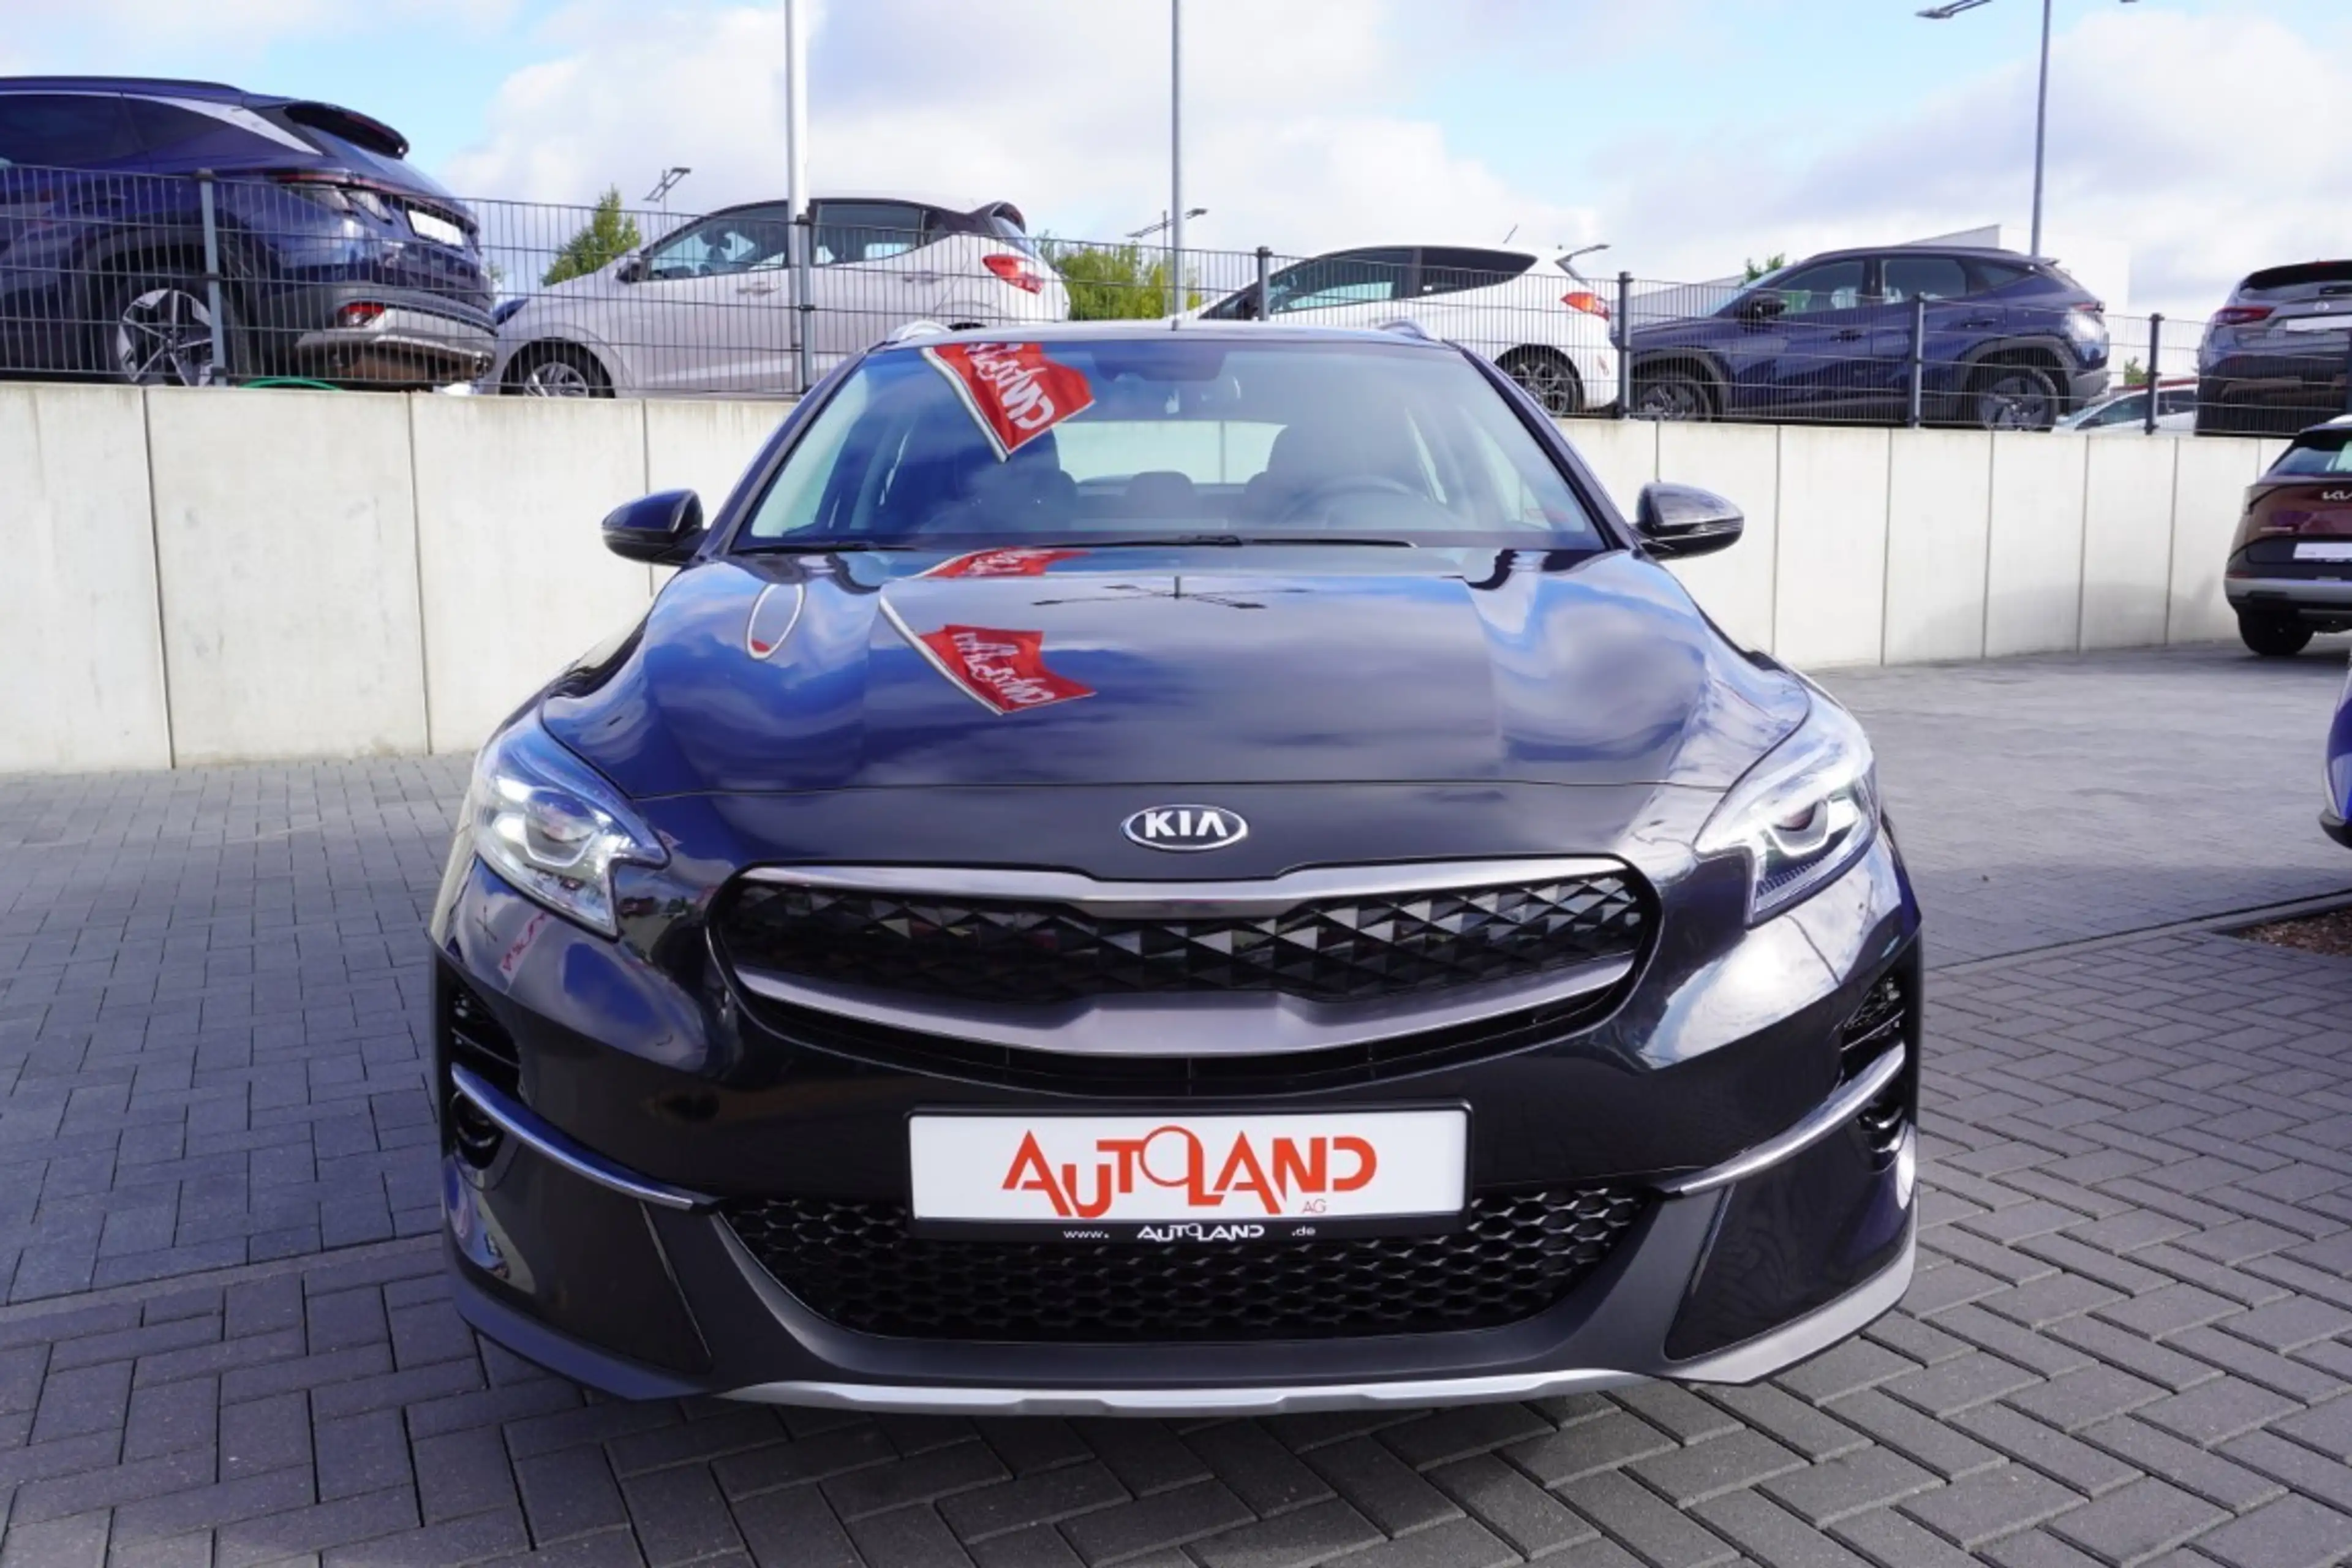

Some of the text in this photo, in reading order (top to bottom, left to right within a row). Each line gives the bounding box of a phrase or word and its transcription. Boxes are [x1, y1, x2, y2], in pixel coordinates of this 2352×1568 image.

[1145, 810, 1228, 839] KIA
[1001, 1125, 1377, 1218] AUTOLAND
[1302, 1199, 1327, 1214] AG
[1137, 1223, 1265, 1243] AUTOLAND
